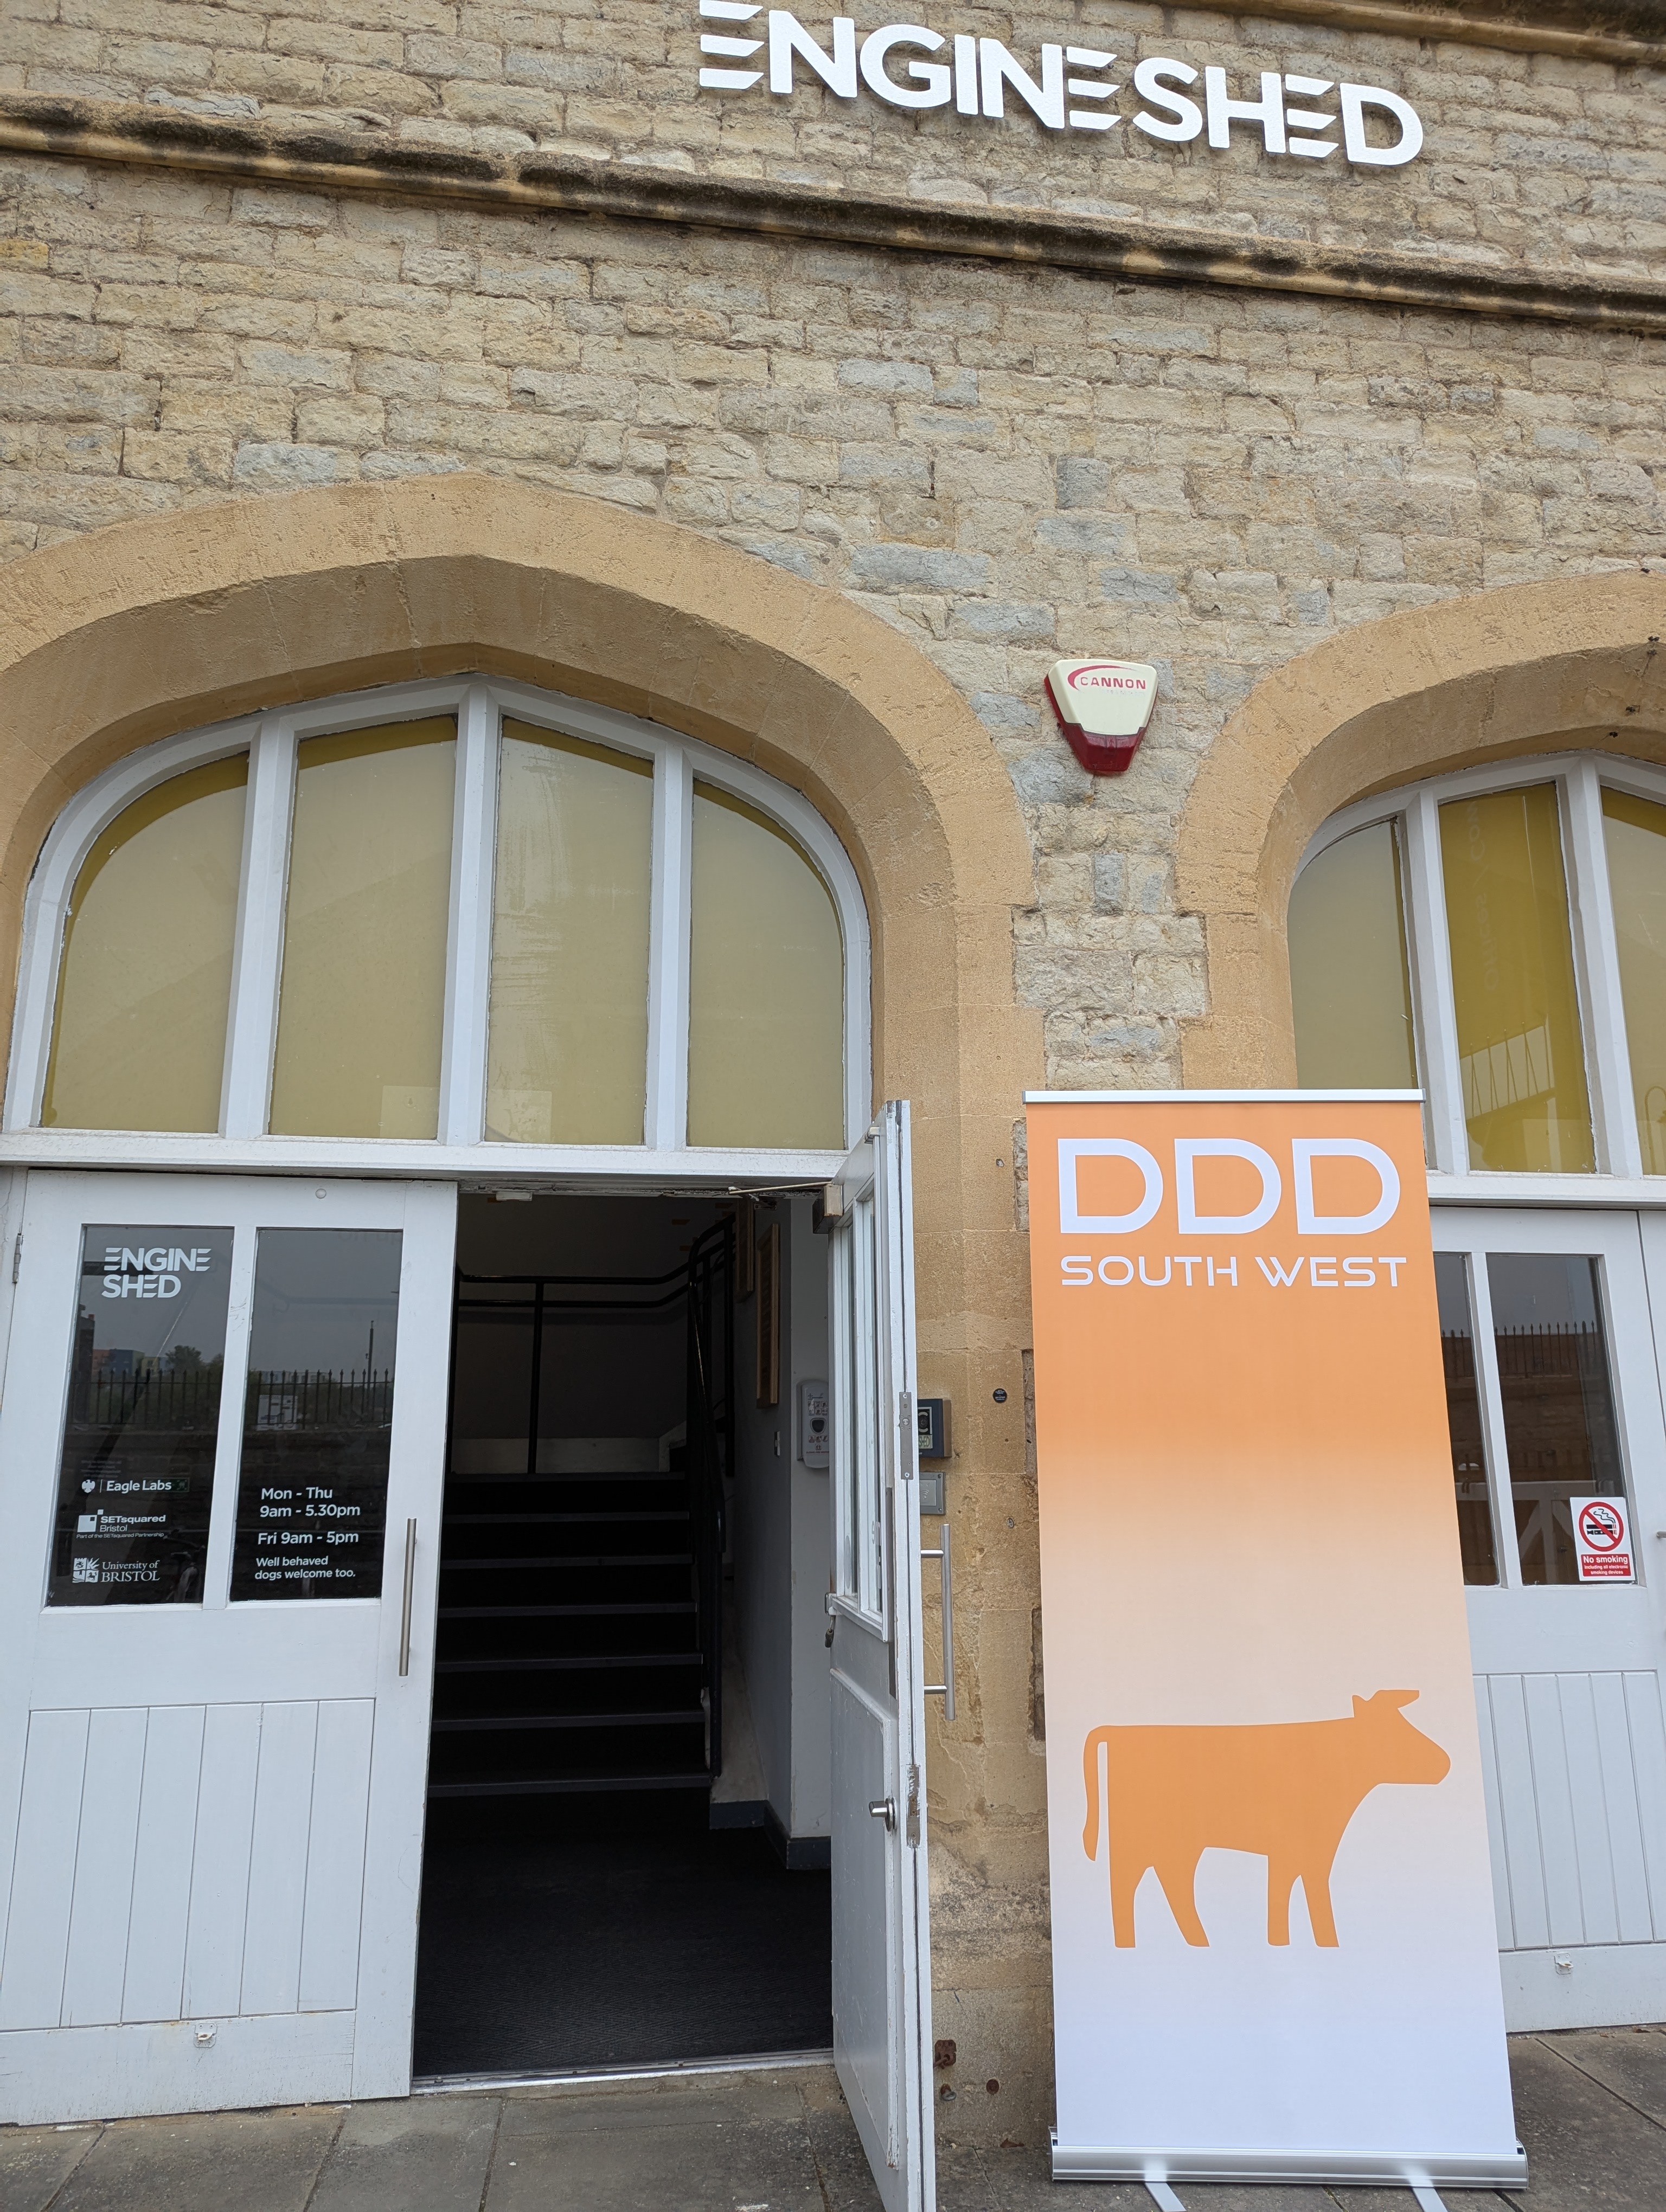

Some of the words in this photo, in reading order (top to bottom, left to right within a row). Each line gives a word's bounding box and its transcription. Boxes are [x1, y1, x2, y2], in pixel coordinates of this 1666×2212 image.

[1080, 677, 1146, 690] CANNON
[1058, 1137, 1401, 1234] DDD
[104, 1248, 212, 1271] ENGINE
[1060, 1256, 1239, 1287] SOUTH
[1254, 1256, 1407, 1287] WEST
[101, 1274, 181, 1298] SHED
[106, 1480, 140, 1494] Eagle
[142, 1480, 172, 1491] Labs
[261, 1488, 292, 1500] Mon
[306, 1487, 333, 1499] Thu
[260, 1506, 292, 1517] 9am
[305, 1504, 361, 1518] 5.30pm
[100, 1515, 166, 1524] SETsquared
[258, 1532, 277, 1545] Fri
[281, 1532, 313, 1544] 9am
[326, 1531, 358, 1545] 5pm
[102, 1561, 148, 1571] University
[149, 1560, 160, 1568] of
[256, 1557, 280, 1567] Well
[282, 1555, 329, 1566] behaved
[1596, 1555, 1628, 1565] smoking
[100, 1571, 160, 1583] BRISTOL
[254, 1570, 281, 1581] dogs
[285, 1569, 332, 1579] welcome
[335, 1568, 356, 1577] too.
